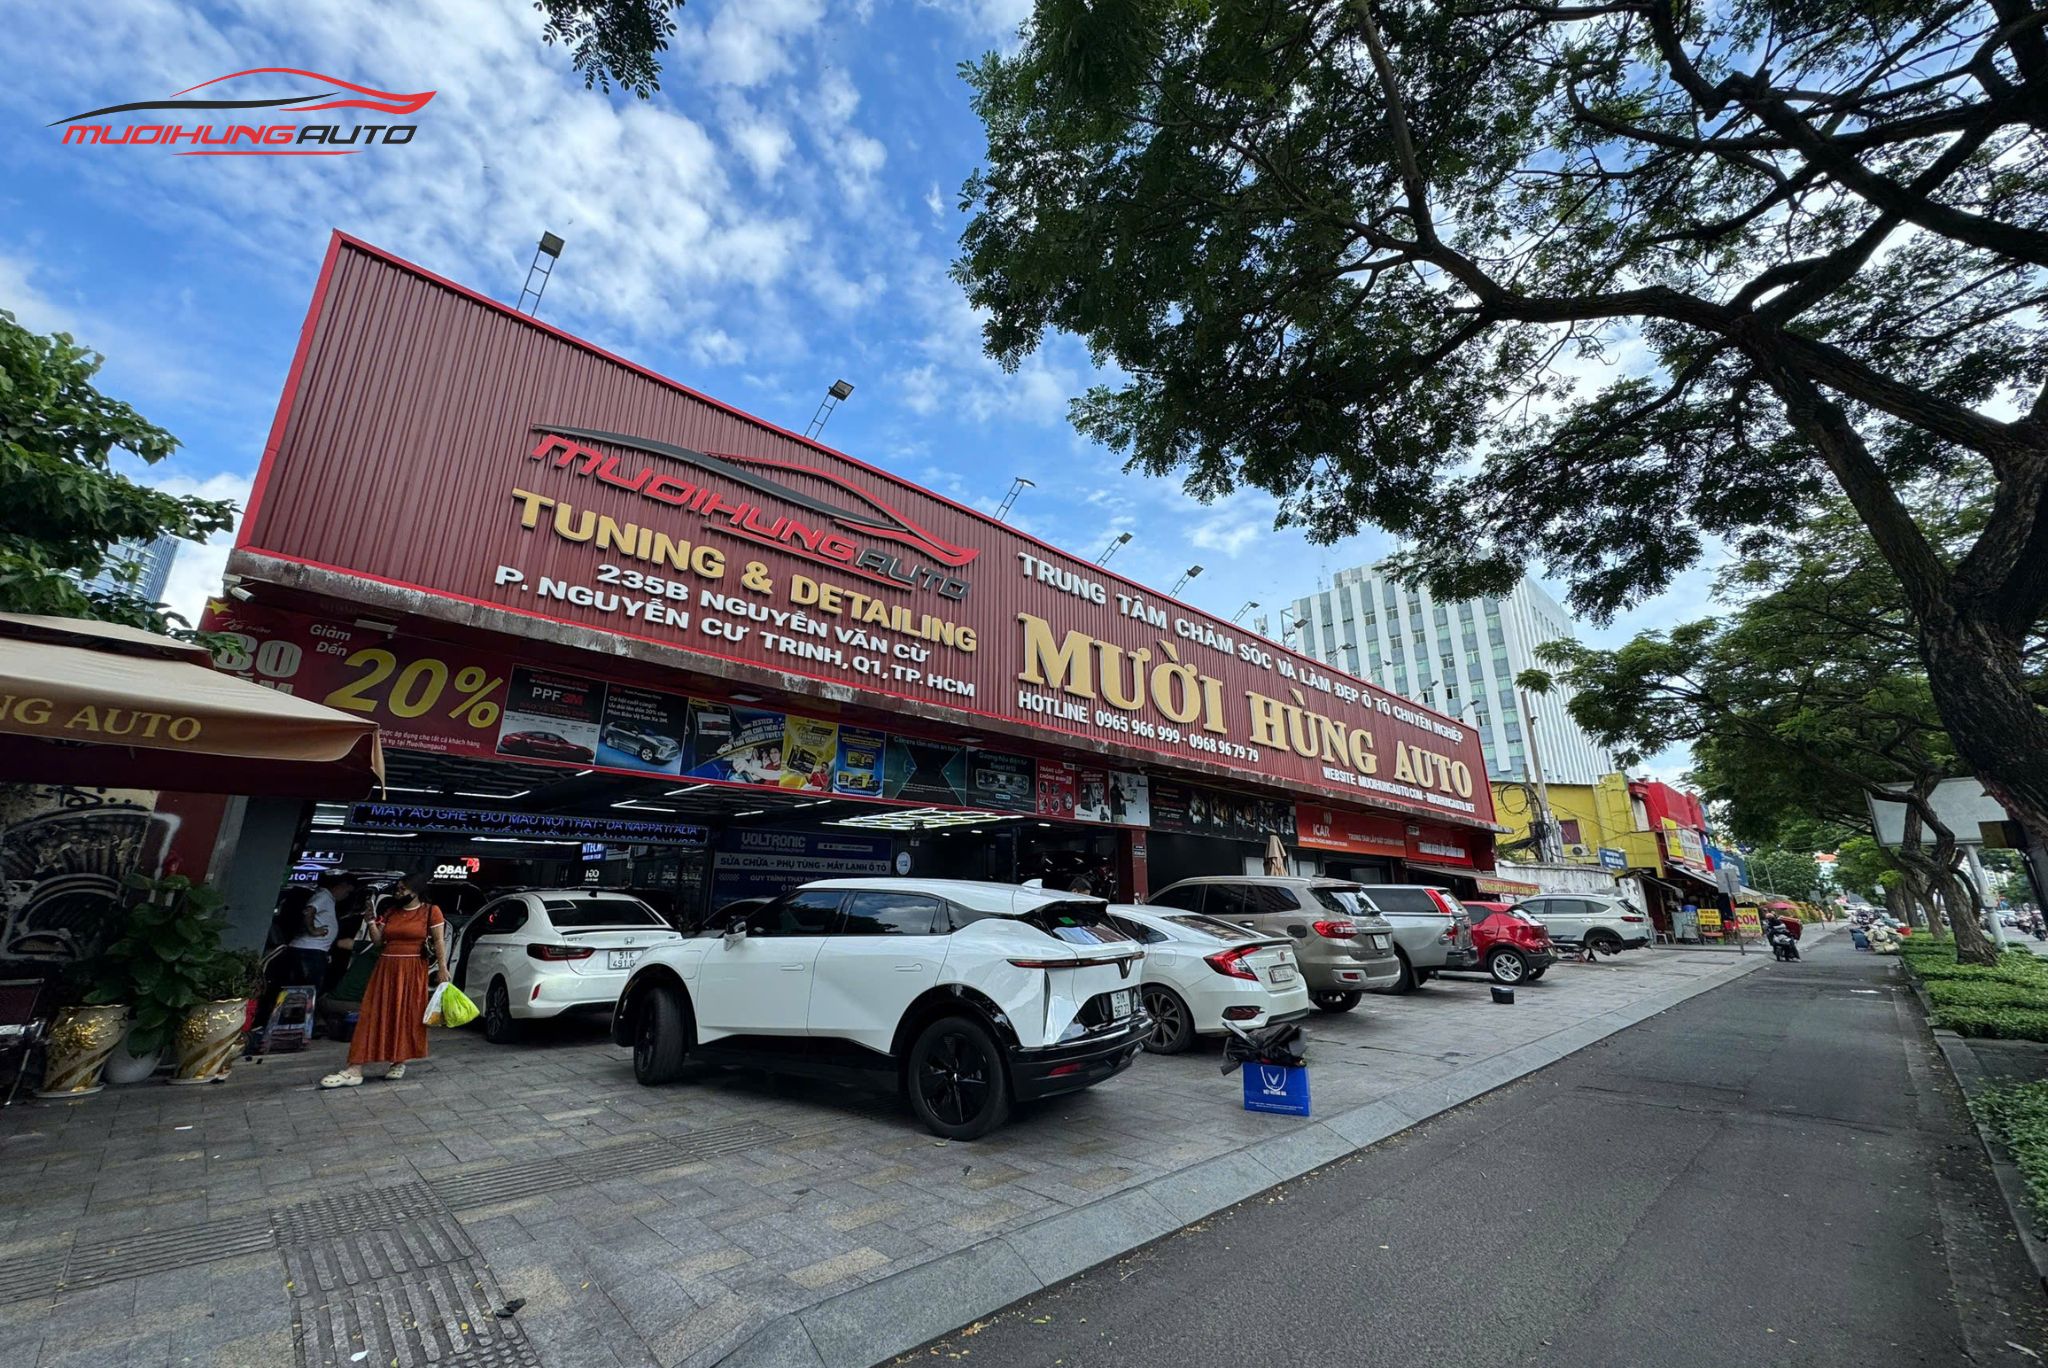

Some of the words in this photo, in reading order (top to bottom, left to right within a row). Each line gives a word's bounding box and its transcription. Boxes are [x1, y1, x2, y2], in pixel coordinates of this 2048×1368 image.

[530, 434, 971, 600] MUOIHUNGAUTO
[512, 487, 726, 579] TUNING
[741, 561, 774, 594] &
[790, 574, 977, 652] DETAILING
[310, 624, 352, 641] Giảm
[494, 565, 529, 592] P.
[536, 577, 690, 630] NGUYỄN
[701, 617, 750, 642] CƯ
[927, 673, 976, 697] HCM
[597, 564, 689, 601] 235B
[700, 589, 828, 639] NGUYỄN
[835, 625, 888, 654] VĂN
[893, 641, 931, 663] CỪ
[316, 641, 348, 657] Đến
[1017, 551, 1107, 605] TRUNG
[1116, 593, 1168, 630] TÂM
[1175, 618, 1234, 655] CHĂM
[1238, 642, 1272, 670] SÓC
[1277, 656, 1297, 681] VÀ
[1299, 668, 1332, 694] LÀM
[1334, 682, 1359, 705] ĐẸP
[1361, 689, 1372, 709] Ô
[1374, 698, 1391, 716] TÔ
[1392, 705, 1433, 732] CHUYÊN
[1433, 721, 1464, 745] NGHIỆP
[323, 648, 504, 729] 20%
[531, 686, 563, 702] PPF
[1017, 611, 1227, 734] MƯỜI
[1244, 688, 1377, 774] HÙNG
[1393, 740, 1473, 799] AUTO
[64, 704, 202, 742] AUTO
[1095, 710, 1128, 732] 0965
[1132, 719, 1155, 738] 966
[1158, 726, 1180, 744] 999
[1189, 733, 1217, 753] 0968
[741, 832, 806, 849] VOLTRONIC
[1312, 823, 1330, 837] ICAR
[720, 854, 740, 866] SỬA
[742, 856, 768, 867] CHỮA
[776, 859, 795, 869] PHỤ
[619, 951, 634, 959] 51K
